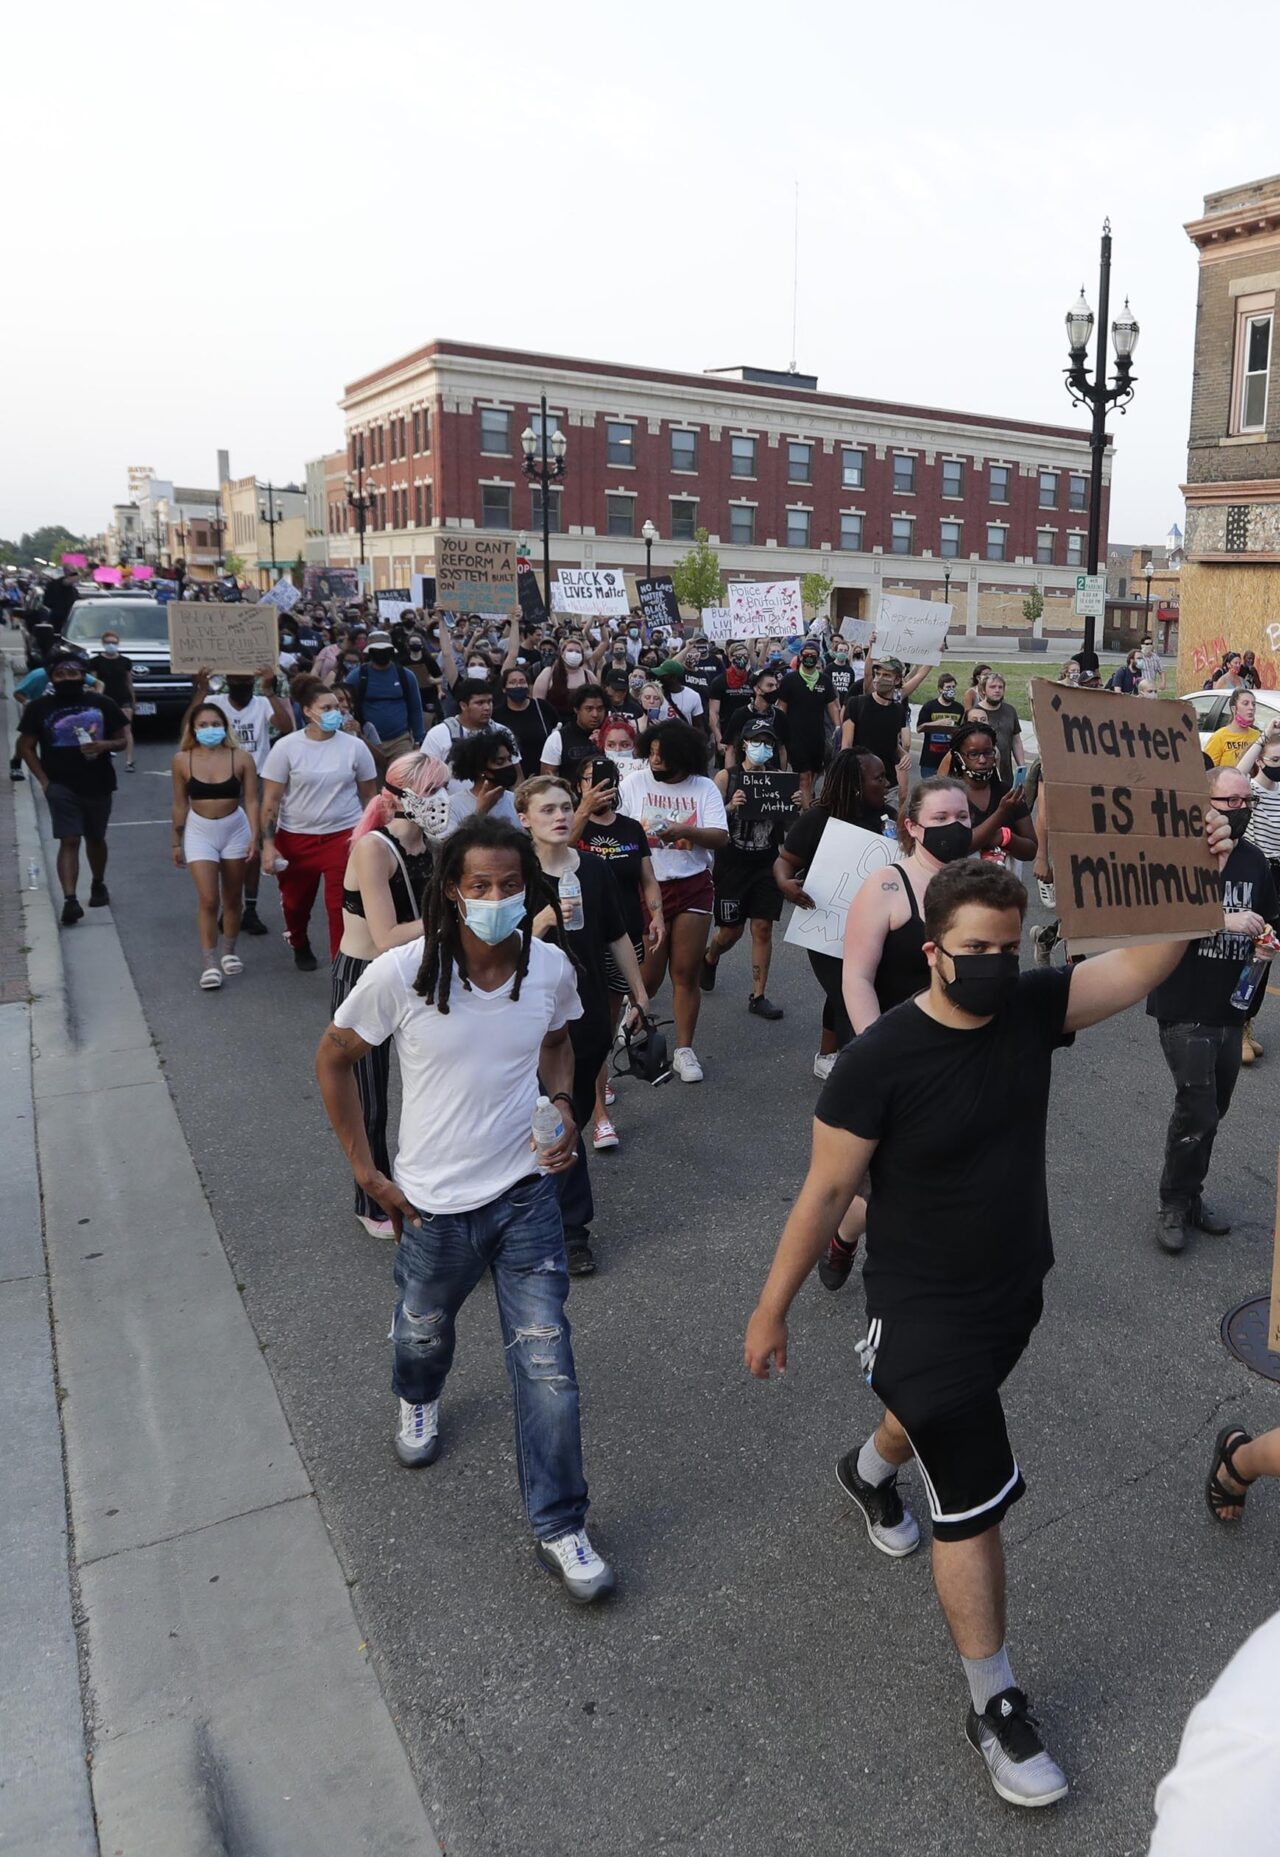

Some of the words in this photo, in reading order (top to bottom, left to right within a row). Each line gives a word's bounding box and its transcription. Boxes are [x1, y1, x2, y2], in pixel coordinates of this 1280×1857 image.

[441, 538, 467, 553] YOU
[475, 542, 511, 554] CANT
[441, 554, 493, 569] REFORM
[500, 559, 511, 570] A
[440, 568, 488, 582] SYSTEM
[492, 573, 514, 582] BUILT
[517, 564, 530, 574] OP
[561, 571, 601, 586] BLACK
[440, 581, 455, 590] ON
[640, 583, 652, 593] NO
[730, 584, 761, 596] Police
[564, 587, 592, 598] LIVES
[596, 586, 625, 599] Matter
[747, 594, 792, 608] Brutality
[644, 603, 668, 615] BLACK
[712, 609, 731, 618] BLAC
[881, 599, 948, 625] Representation
[713, 620, 732, 629] LIV
[758, 624, 797, 637] Lynching
[710, 629, 732, 639] MATT
[882, 632, 929, 656] Liberation
[1190, 635, 1230, 673] BLM
[743, 775, 771, 785] Black
[754, 788, 780, 798] Lives
[647, 792, 697, 811] NIRVANA
[761, 803, 794, 812] Matter
[1151, 788, 1204, 838] the
[1071, 851, 1221, 909] minimum
[1222, 880, 1254, 909] ACK
